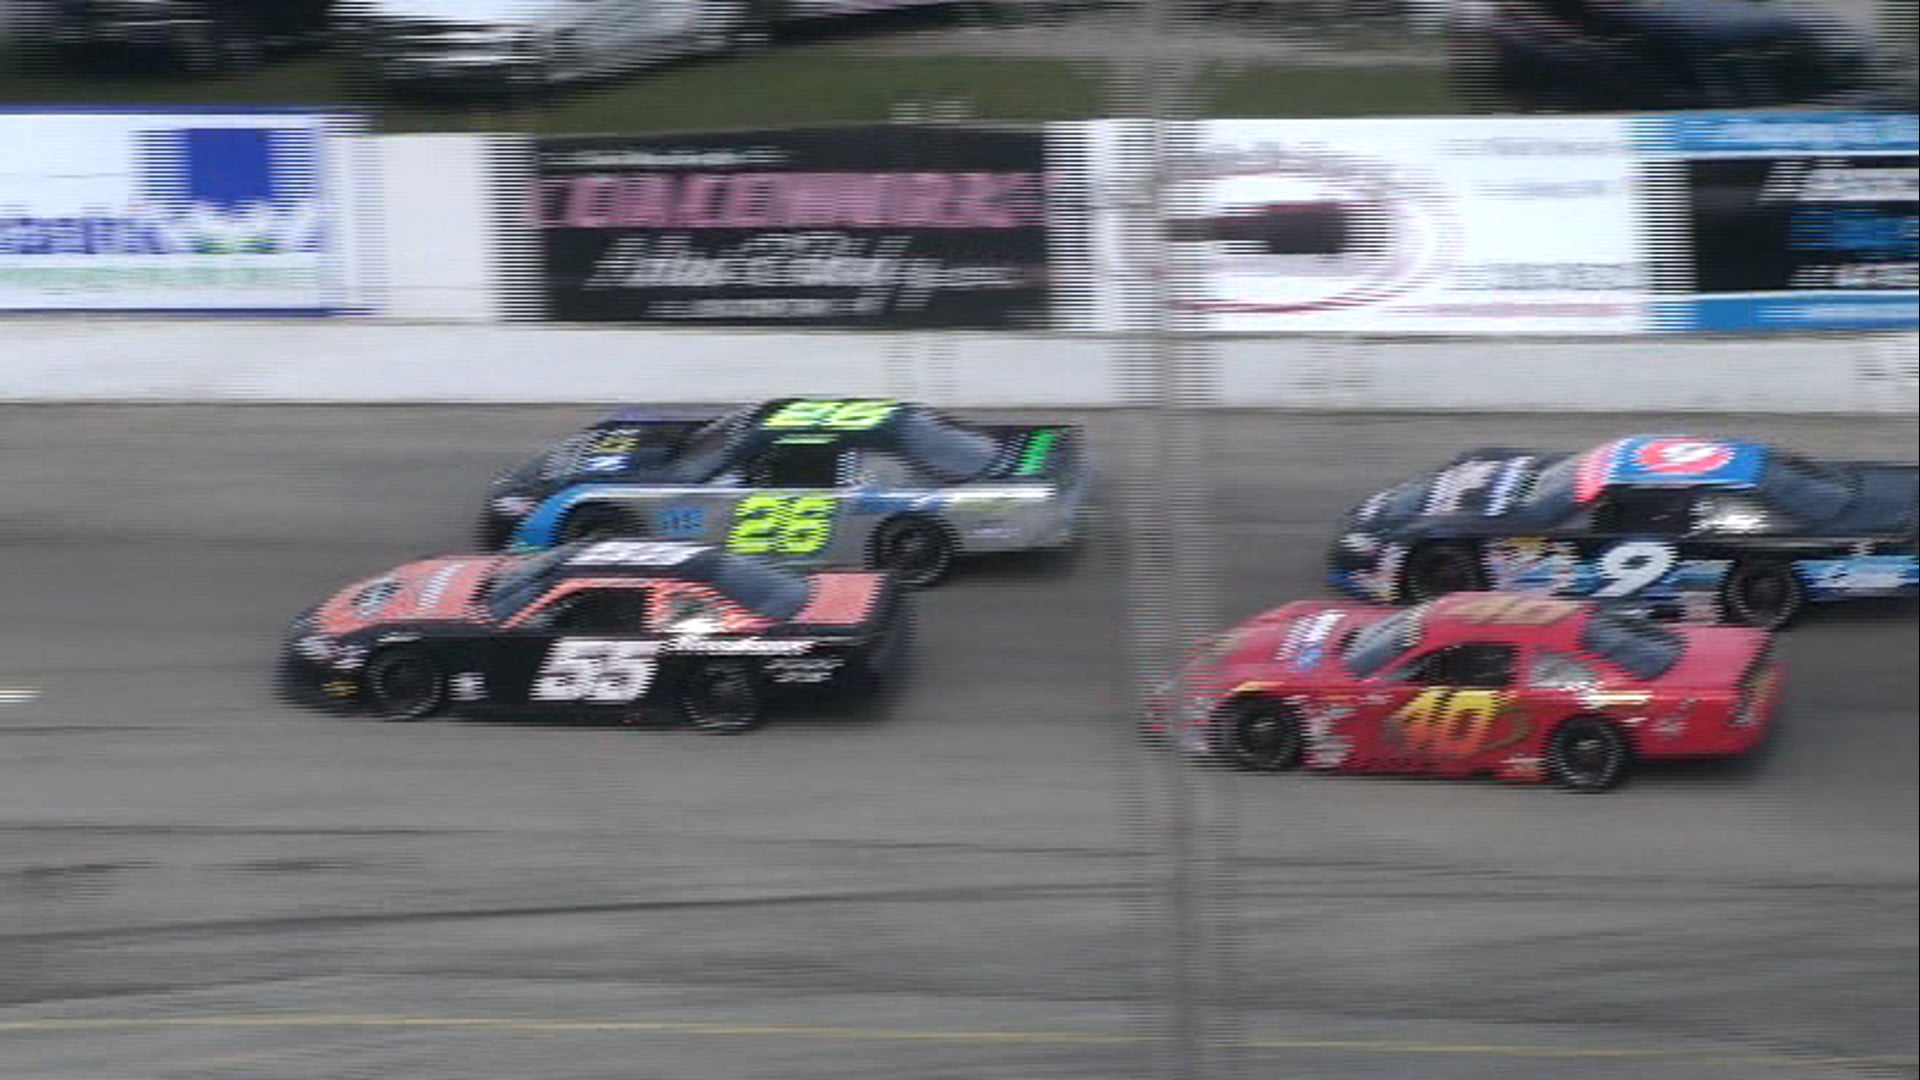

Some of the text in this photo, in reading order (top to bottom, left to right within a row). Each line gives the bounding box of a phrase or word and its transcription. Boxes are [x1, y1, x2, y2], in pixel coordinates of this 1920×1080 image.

[762, 399, 902, 431] 26
[725, 492, 839, 555] 26
[1588, 541, 1678, 597] 9
[530, 639, 667, 702] 55
[1390, 688, 1503, 755] 40
